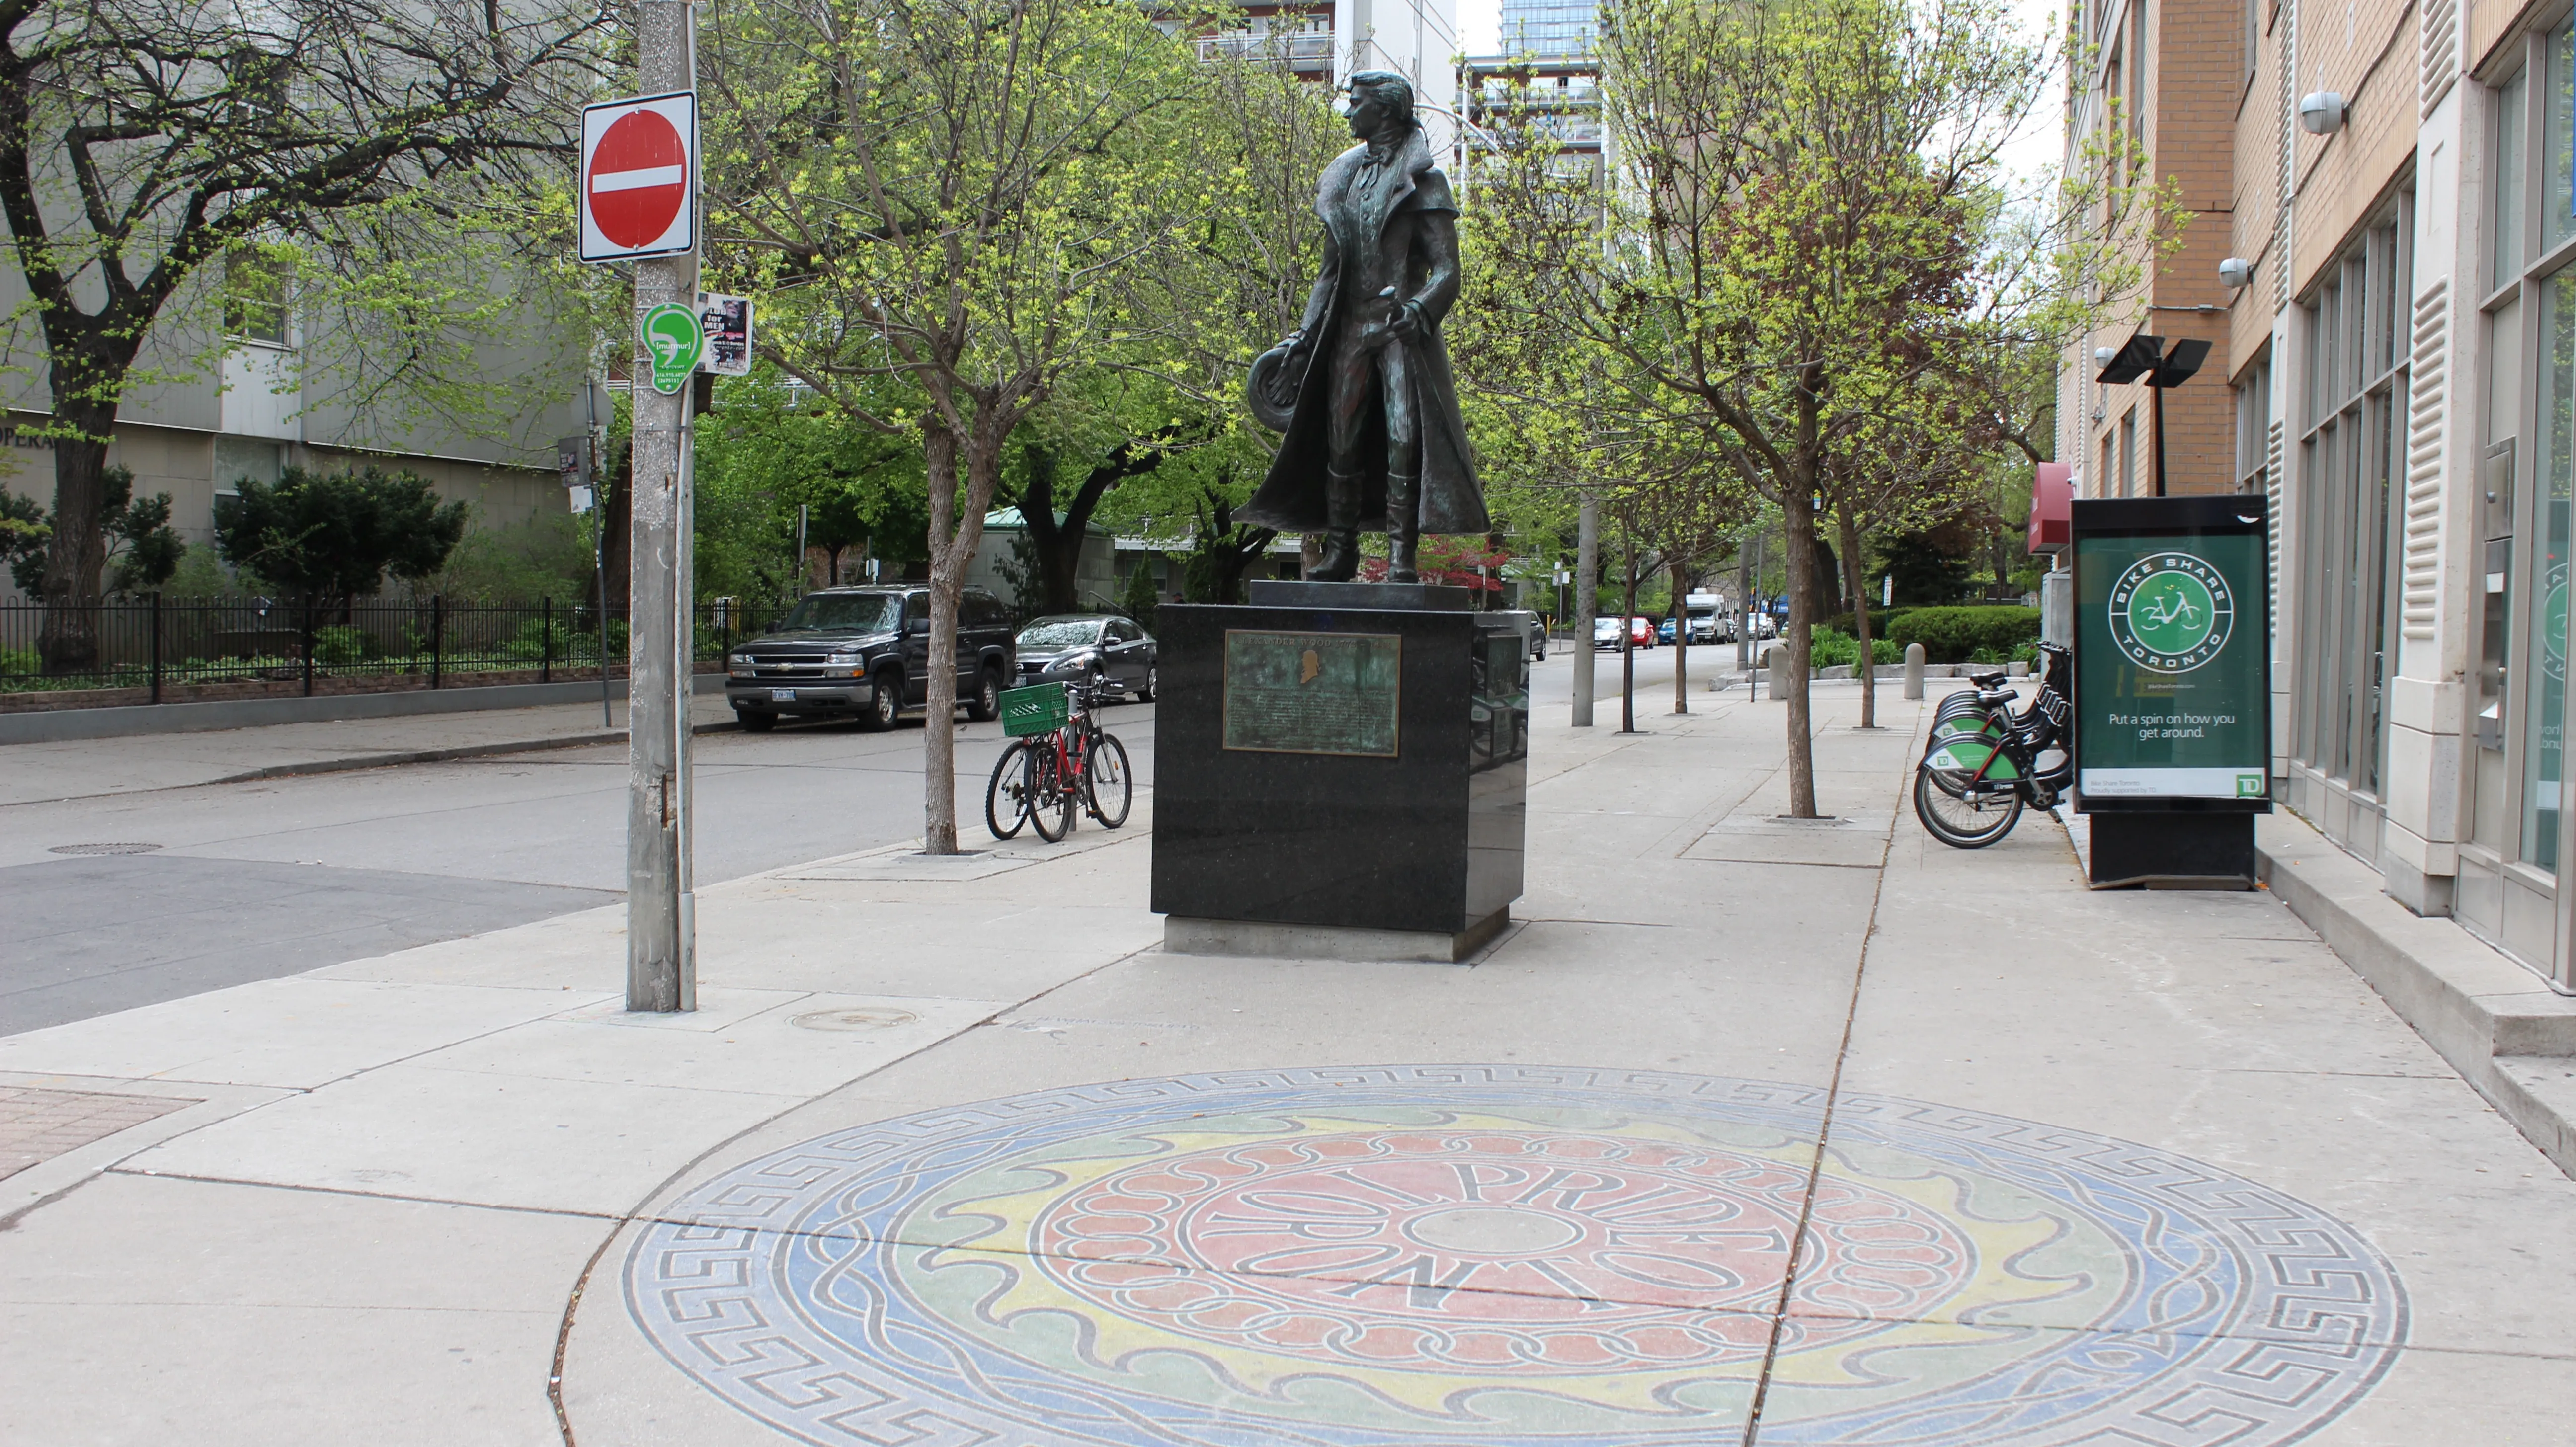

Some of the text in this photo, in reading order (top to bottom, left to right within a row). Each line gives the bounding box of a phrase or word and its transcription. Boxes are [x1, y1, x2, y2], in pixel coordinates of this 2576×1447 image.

[704, 322, 724, 330] MEN
[656, 341, 691, 350] [murmur]
[2116, 558, 2226, 604] BIKE SHARE
[1234, 637, 1296, 646] ALEXANDER
[1301, 638, 1332, 647] WOOD
[2123, 633, 2221, 668] TORONTO
[2109, 712, 2235, 726] Put a spin on how you
[2139, 726, 2205, 741] get around.
[2238, 778, 2260, 793] TD
